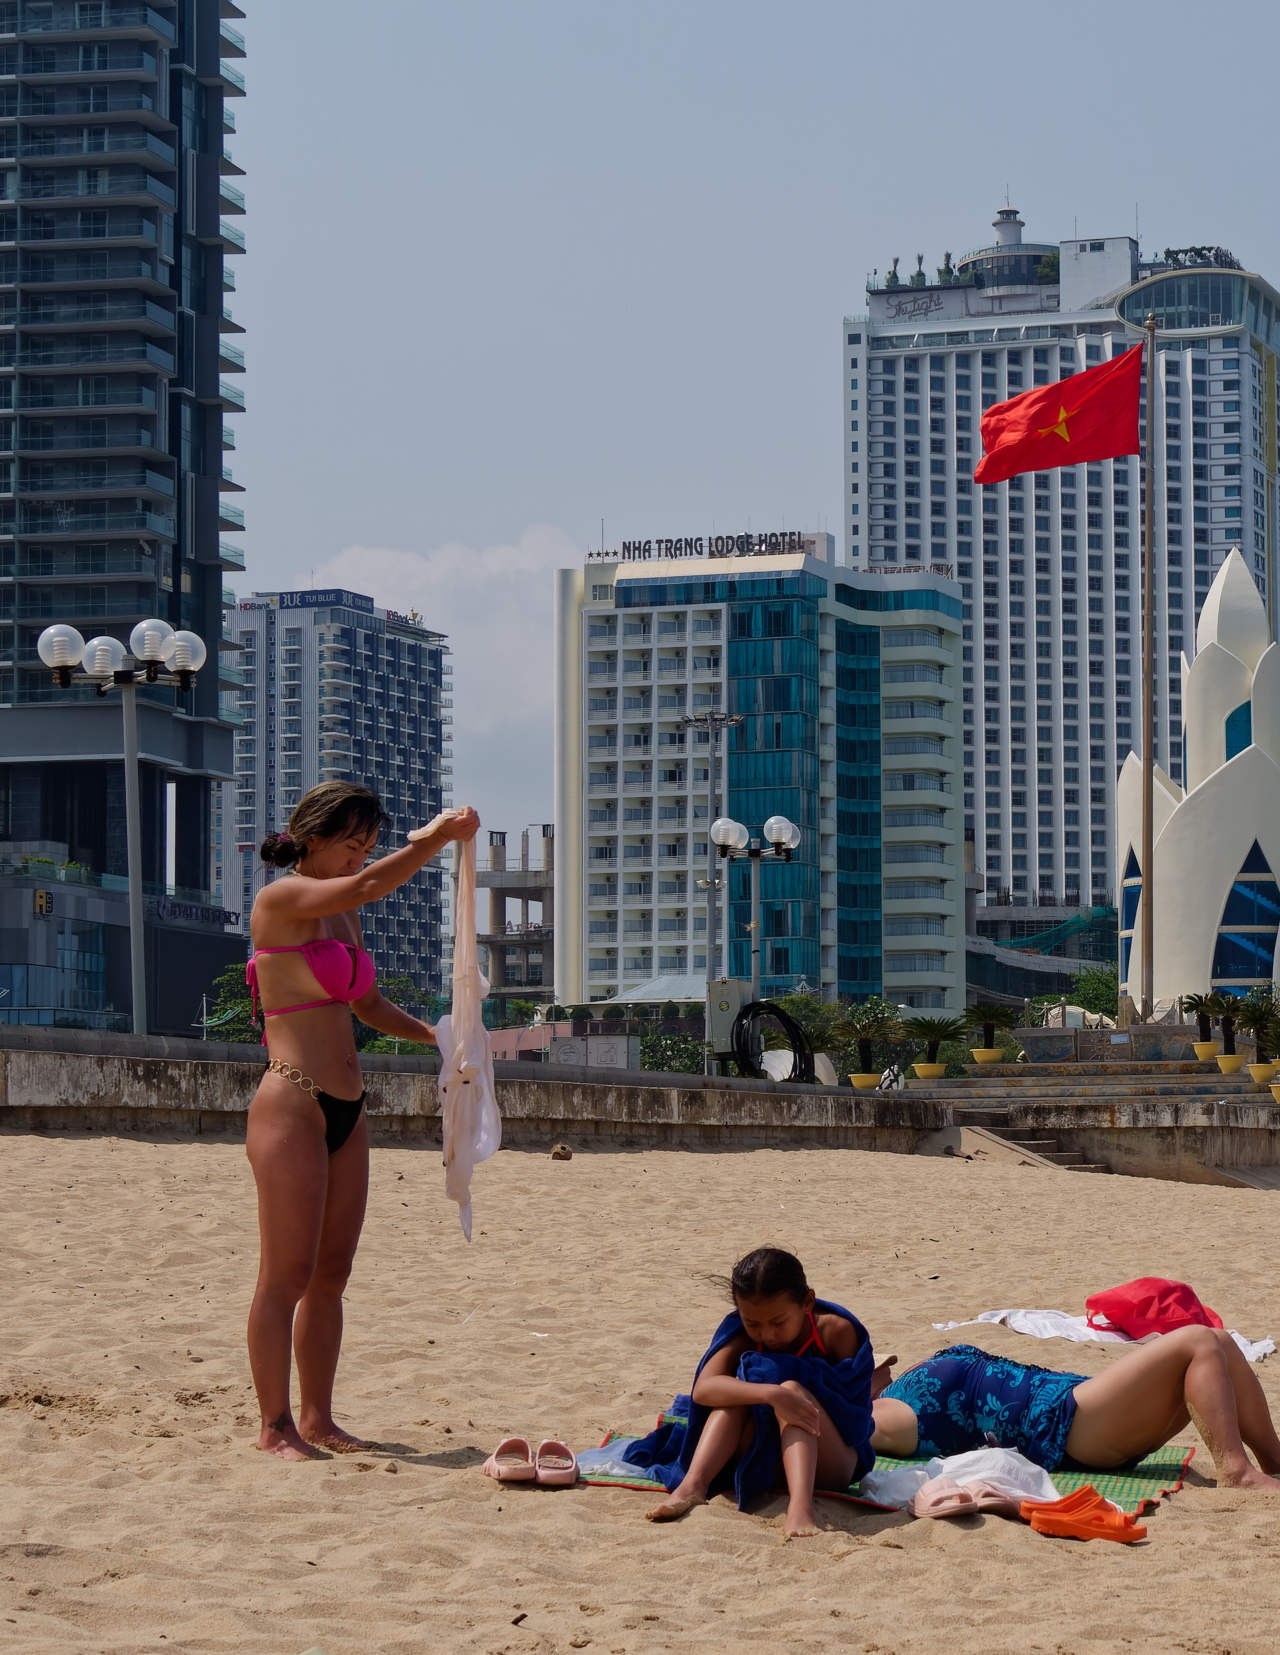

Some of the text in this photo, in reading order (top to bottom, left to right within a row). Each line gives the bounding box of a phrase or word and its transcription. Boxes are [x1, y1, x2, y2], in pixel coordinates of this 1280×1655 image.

[622, 531, 804, 562] NHA TRANG LODGE HOTEL
[240, 602, 270, 611] HDBank
